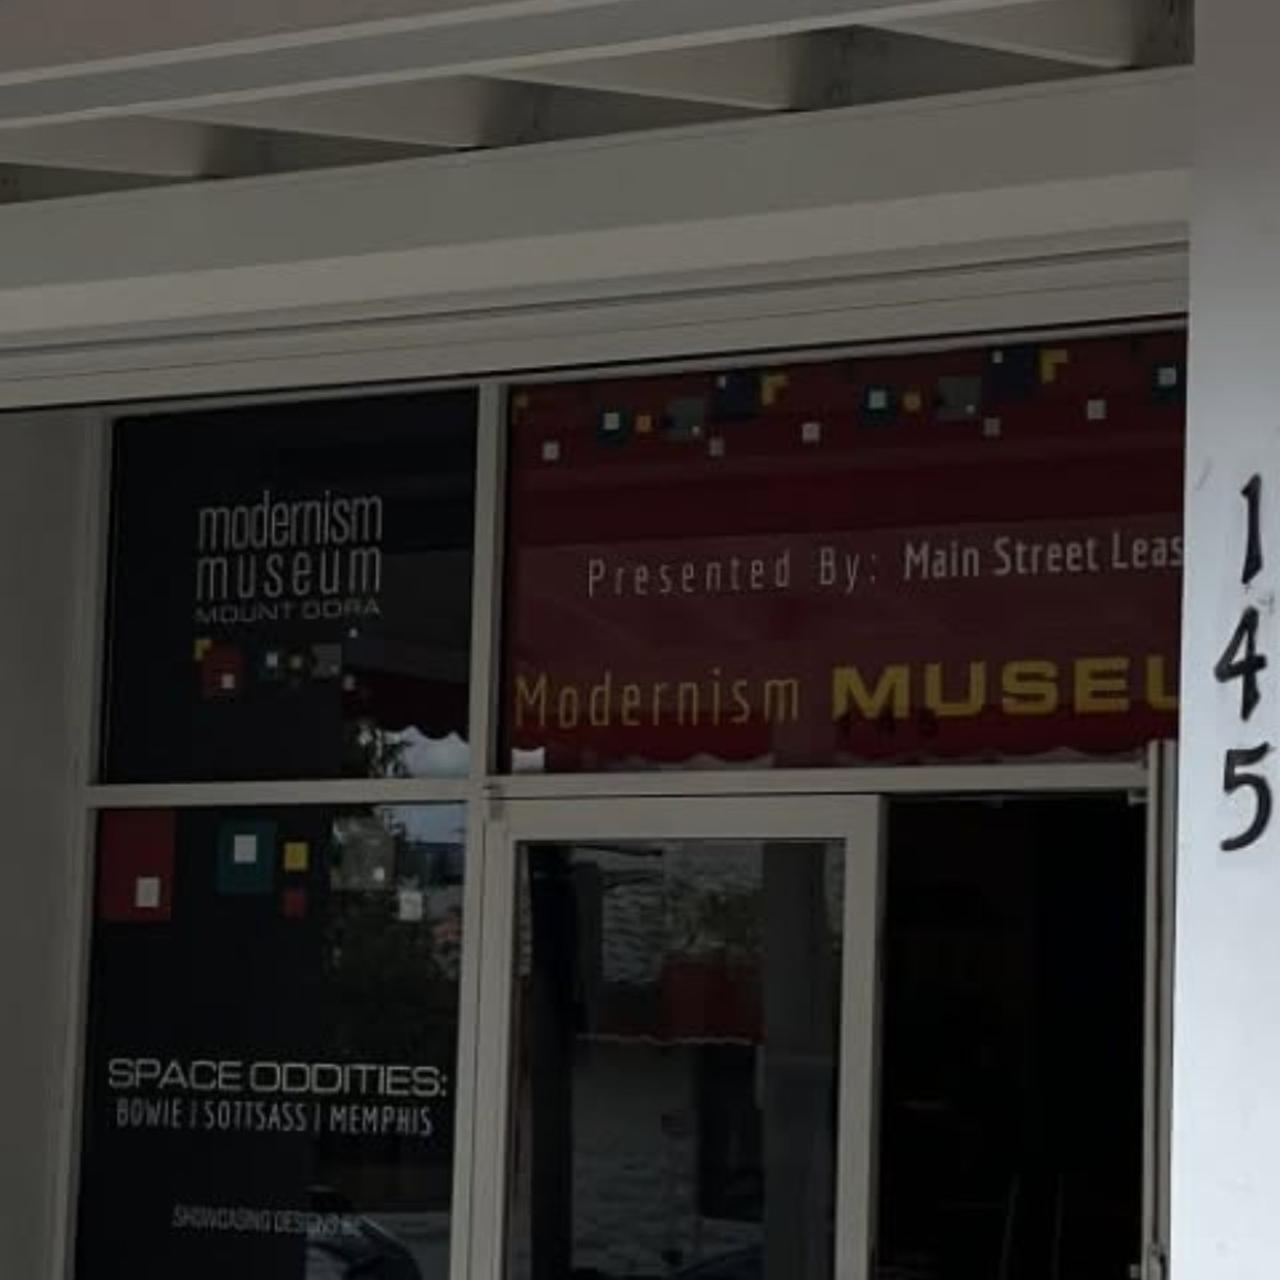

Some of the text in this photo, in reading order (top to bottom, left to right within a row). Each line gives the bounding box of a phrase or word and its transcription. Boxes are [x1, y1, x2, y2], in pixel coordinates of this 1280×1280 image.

[197, 488, 384, 552] modernism
[195, 546, 383, 601] museum
[586, 529, 1183, 599] Presented By: Main Street Leas
[195, 598, 382, 623] MOUNT DORA
[515, 667, 801, 729] Modernism
[107, 1057, 448, 1097] SPACE ODDITIES:
[116, 1097, 435, 1137] BOWIE SOTTSASS MEMPHIS
